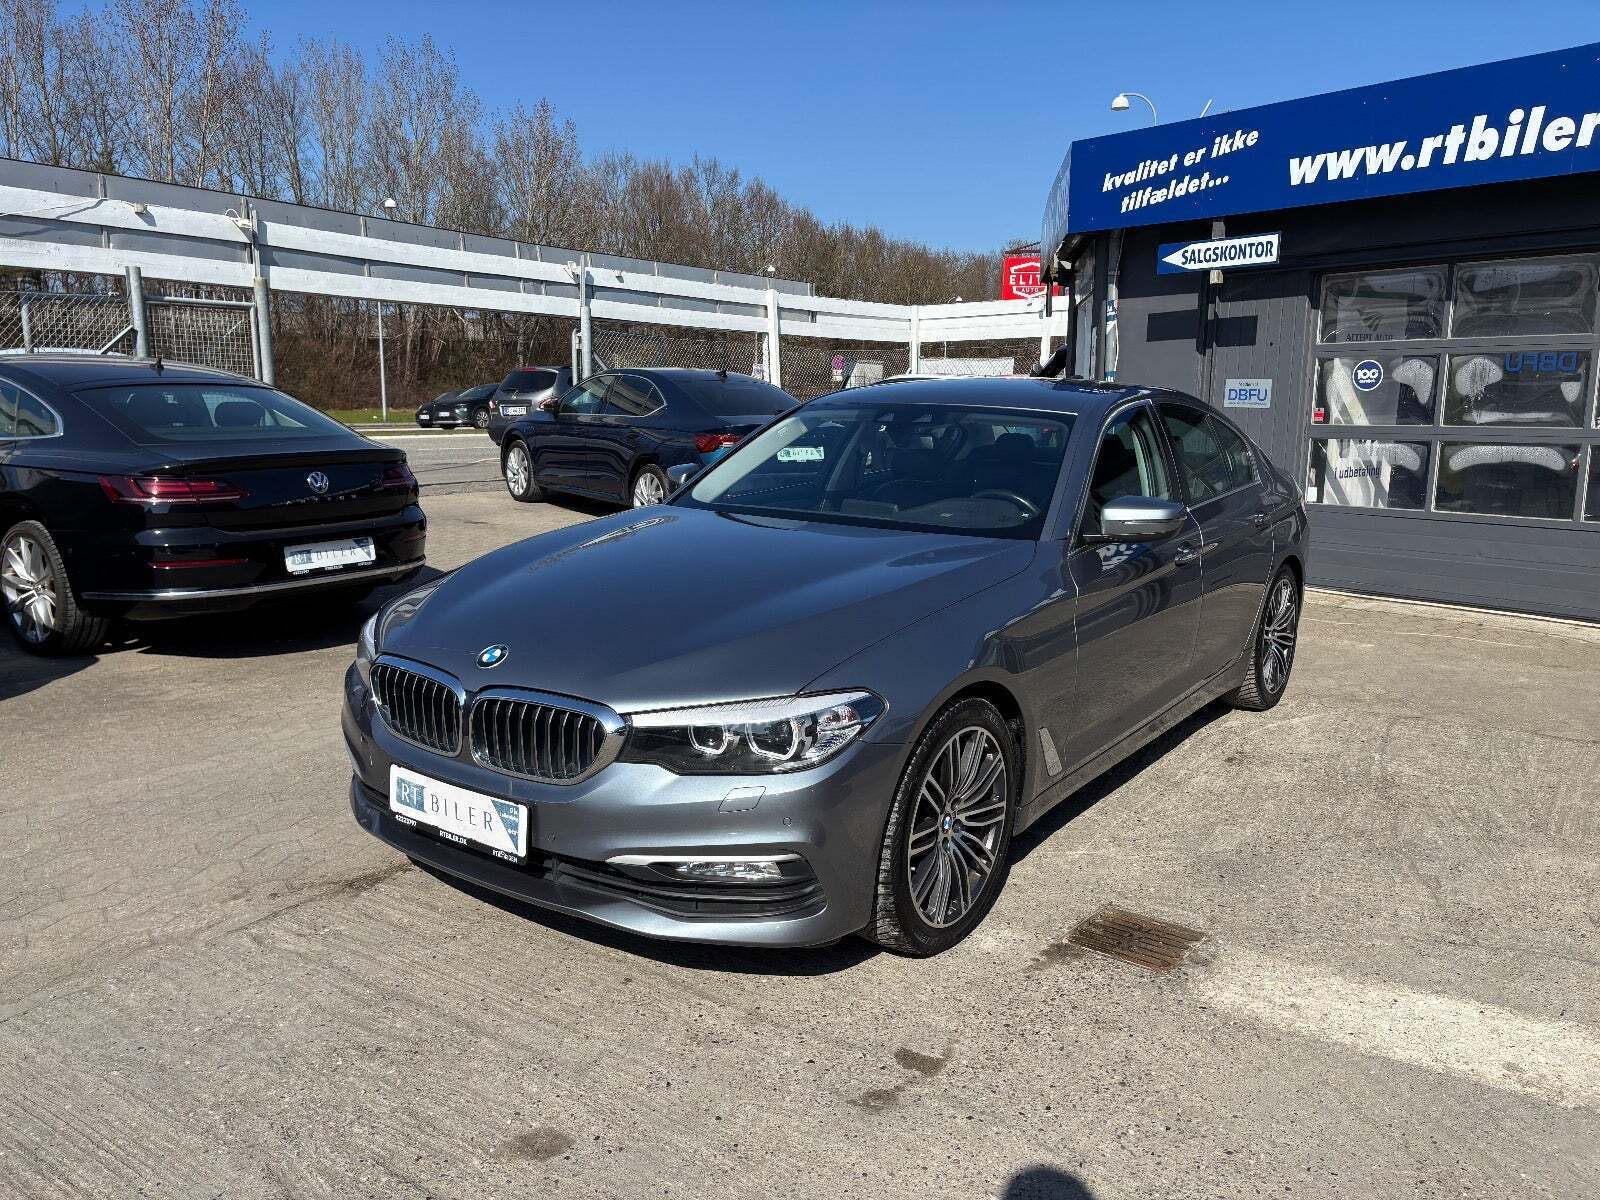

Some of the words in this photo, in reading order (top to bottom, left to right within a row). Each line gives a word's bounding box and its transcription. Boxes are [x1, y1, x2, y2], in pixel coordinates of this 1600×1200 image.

[1289, 105, 1600, 186] www.rtbiler
[1102, 154, 1178, 192] kvalitet
[1182, 147, 1206, 168] er
[1210, 128, 1259, 158] ikke
[1120, 171, 1231, 214] tilfældet...
[1180, 240, 1274, 265] SALGSKONTOR
[1009, 274, 1041, 285] ELIT
[1356, 368, 1379, 380] 100
[1227, 388, 1268, 402] DBFU
[1338, 464, 1380, 479] udbetaling
[401, 784, 420, 804] RT
[431, 794, 492, 831] BILER
